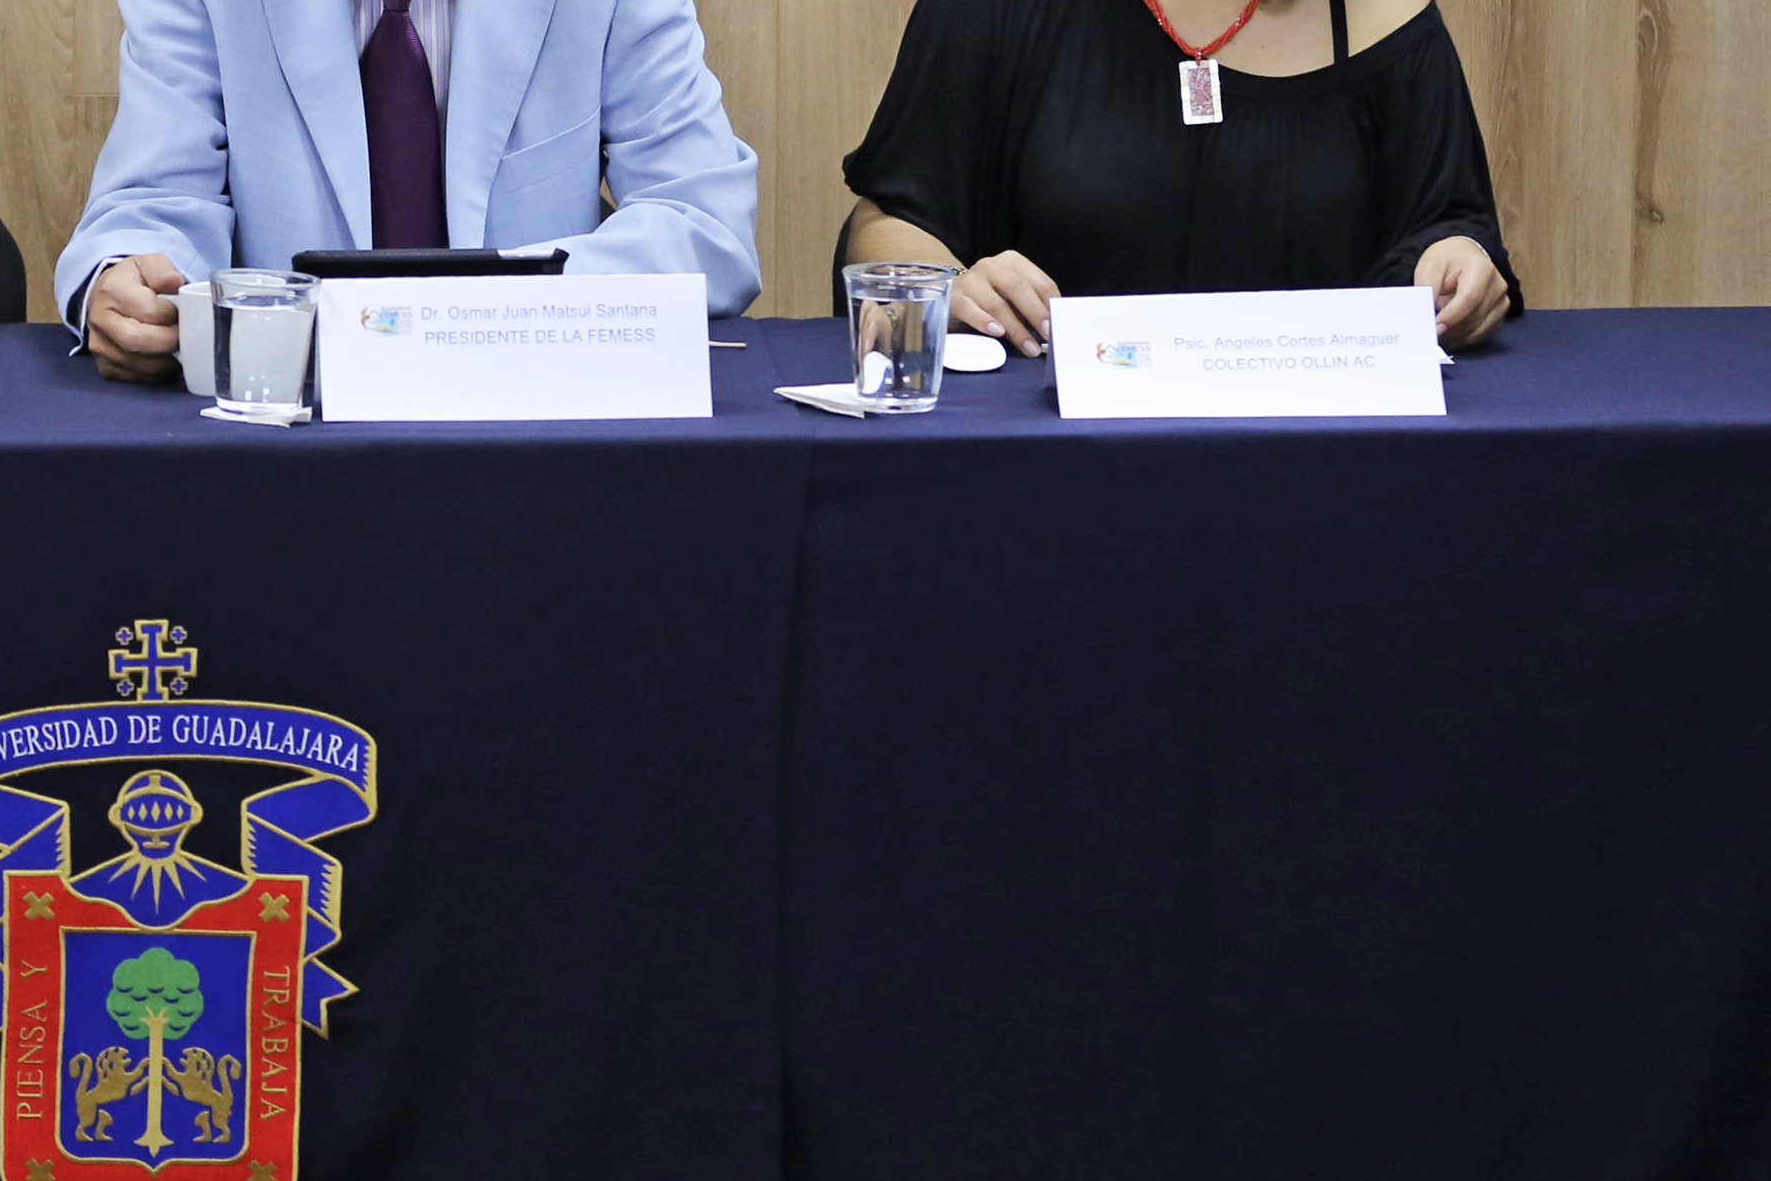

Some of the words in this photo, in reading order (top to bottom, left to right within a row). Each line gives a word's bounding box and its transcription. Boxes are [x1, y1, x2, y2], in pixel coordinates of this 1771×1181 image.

[421, 307, 442, 320] Dr.
[448, 306, 497, 319] Osmar
[502, 306, 537, 319] Juan
[542, 304, 591, 318] Matsui
[596, 304, 657, 317] Santana
[425, 330, 529, 345] PRESIDENTE
[535, 330, 557, 343] DE
[563, 329, 583, 343] LA
[588, 328, 655, 342] FEMESS
[1174, 337, 1209, 349] Psic.
[1215, 336, 1272, 350] Angeles
[1278, 335, 1325, 348] Cortes
[1330, 334, 1400, 348] Almaguer
[1203, 357, 1296, 370] COLECTIVO
[1302, 356, 1348, 369] OLLIN
[1353, 355, 1375, 367] AC
[128, 715, 162, 744] DE
[173, 715, 360, 772] GUADALAJARA
[20, 960, 48, 981] Y
[260, 966, 290, 1121] TRABAJA
[16, 999, 48, 1121] PIENSA
